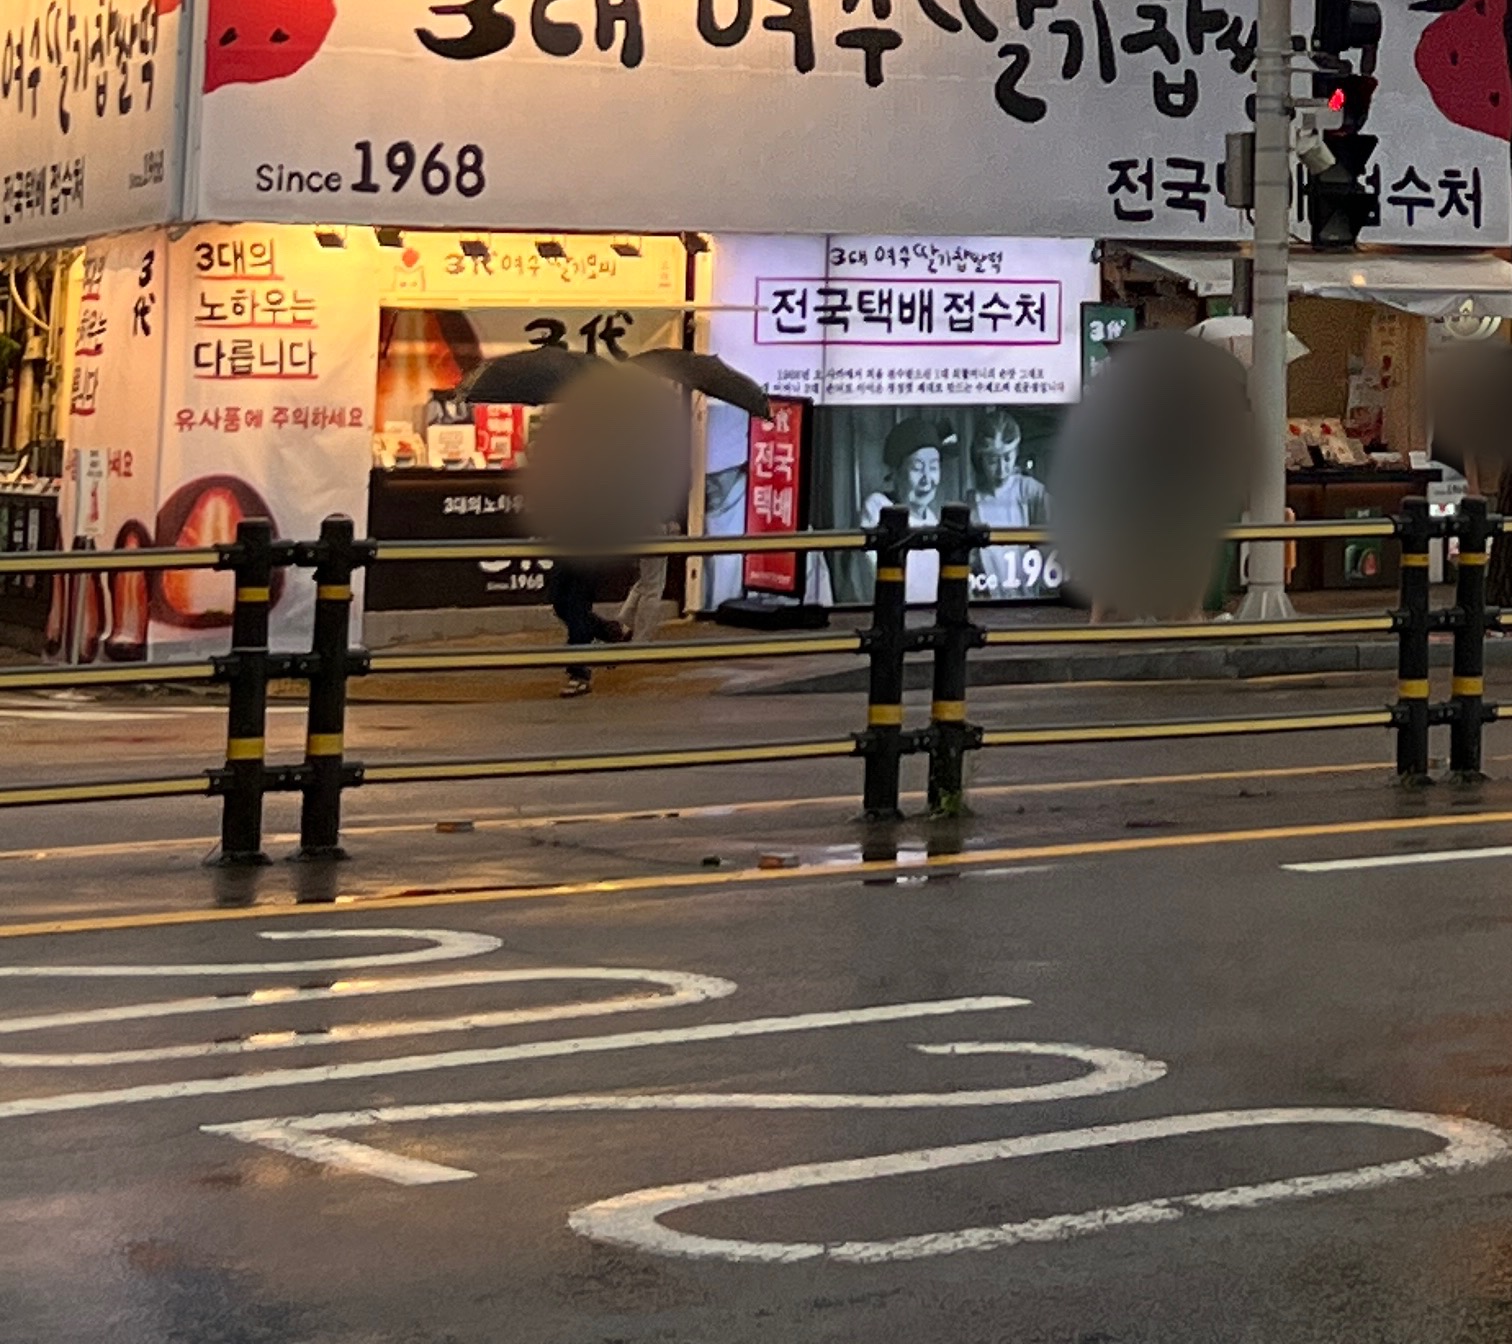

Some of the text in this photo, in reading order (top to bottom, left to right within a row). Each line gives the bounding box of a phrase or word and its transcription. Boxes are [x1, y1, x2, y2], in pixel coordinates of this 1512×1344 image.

[255, 140, 487, 199] Since 1968
[194, 240, 277, 276] 3대의
[829, 246, 869, 267] 3대
[195, 288, 318, 326] 노하우는
[771, 287, 1047, 334] 전국택배 접수처
[194, 338, 319, 377] 다릅니다
[174, 405, 364, 433] 유사품에 주의하세요
[753, 441, 795, 482] 전국
[752, 484, 794, 527] 택배
